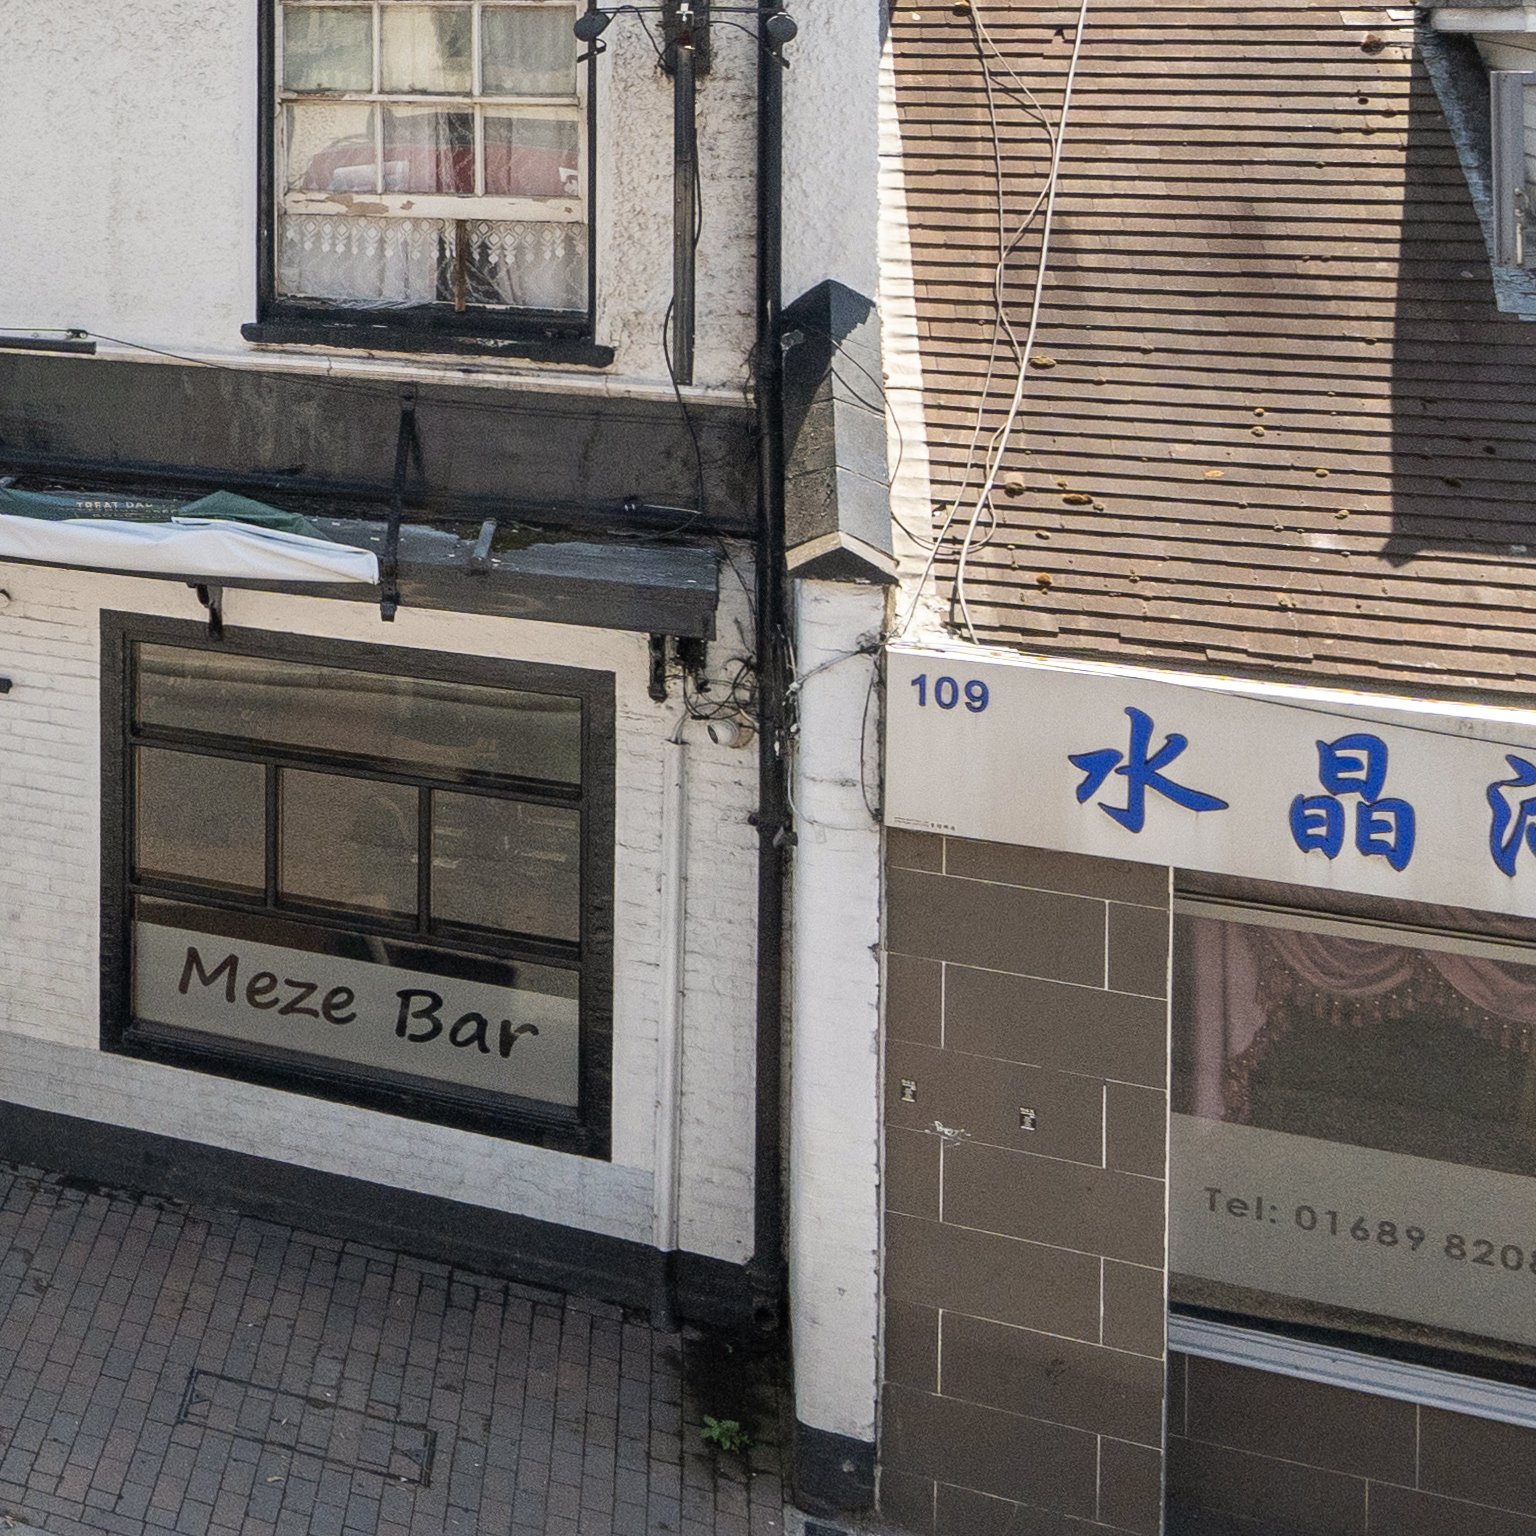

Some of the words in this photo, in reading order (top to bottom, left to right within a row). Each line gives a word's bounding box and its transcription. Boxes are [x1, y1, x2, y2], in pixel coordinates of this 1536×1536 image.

[911, 673, 990, 713] 109
[179, 946, 357, 1026] Meze
[396, 988, 539, 1058] Bar
[1204, 1186, 1277, 1224] Tel:
[1294, 1205, 1426, 1252] 01689
